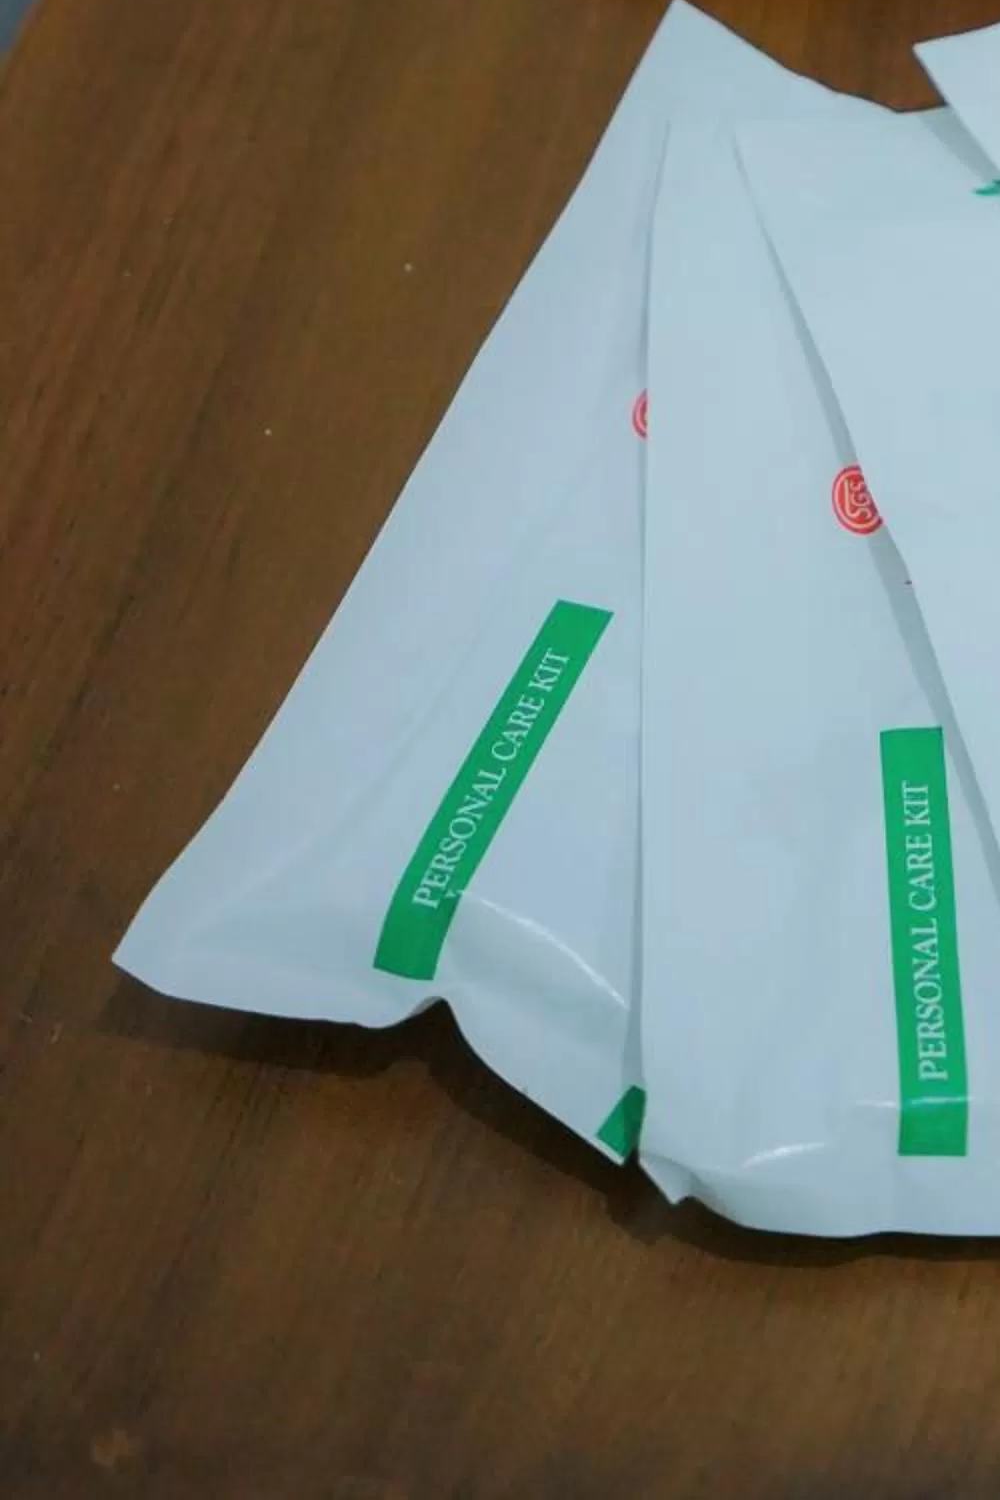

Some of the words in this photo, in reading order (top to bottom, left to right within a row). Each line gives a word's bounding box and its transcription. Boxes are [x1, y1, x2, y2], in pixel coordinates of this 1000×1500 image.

[411, 767, 507, 909] PERSONAL
[490, 694, 545, 763] CARE
[526, 647, 569, 694] KIT
[901, 779, 931, 826] KIT
[905, 832, 936, 911] CARE
[911, 916, 948, 1080] PERSONAL
